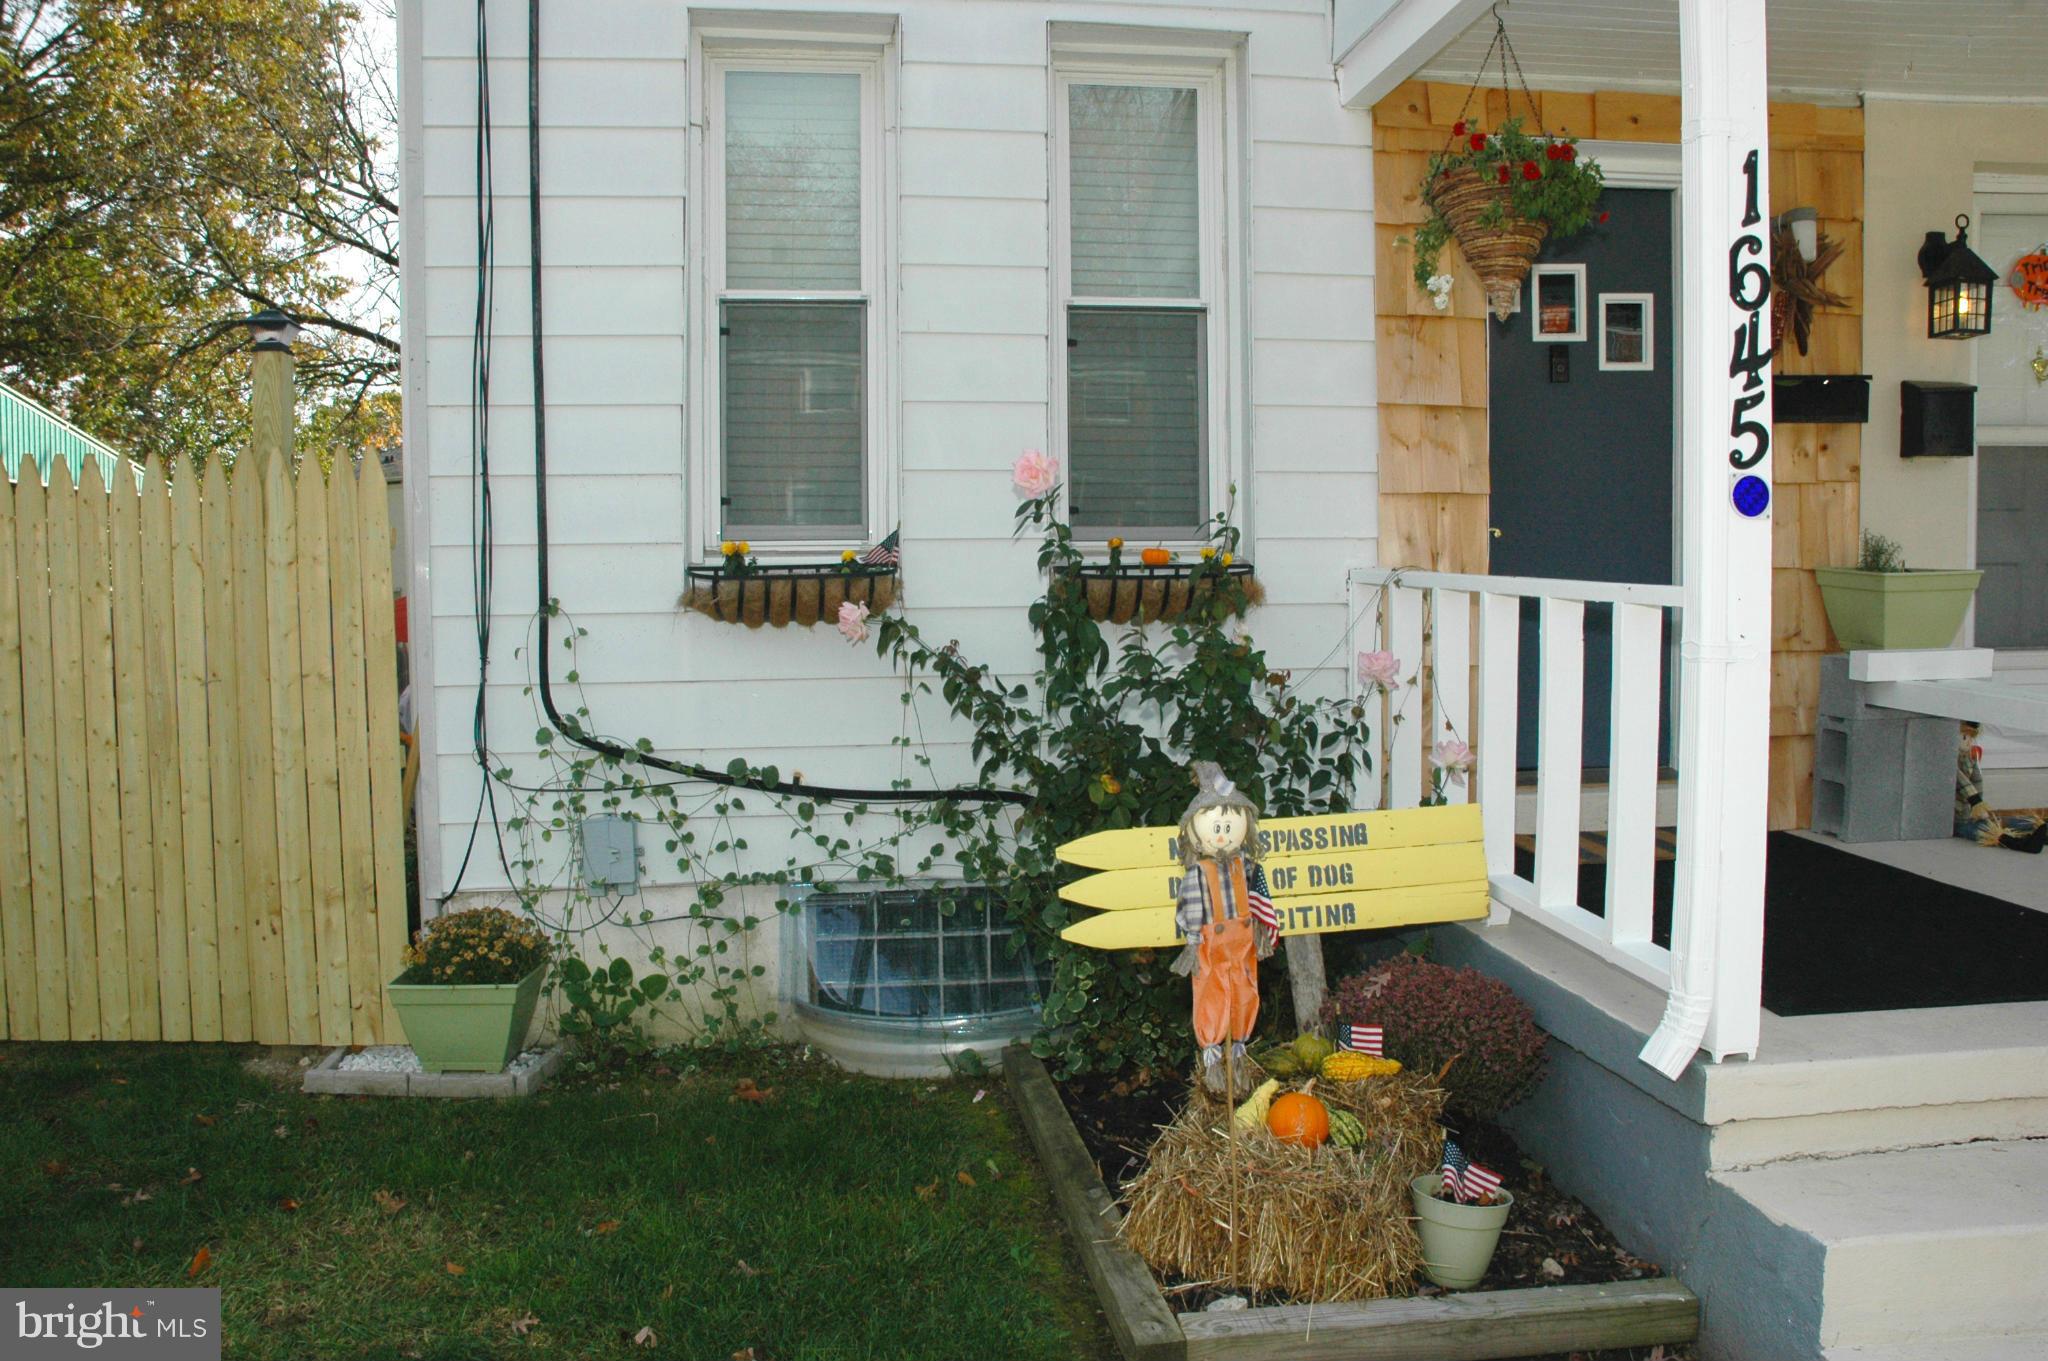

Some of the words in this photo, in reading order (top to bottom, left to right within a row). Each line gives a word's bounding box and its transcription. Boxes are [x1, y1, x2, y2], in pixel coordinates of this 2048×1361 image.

[1729, 149, 1772, 470] 1645
[1258, 822, 1368, 853] SPASSING
[1272, 866, 1297, 890] OF
[1307, 862, 1354, 888] DOG
[1274, 902, 1356, 931] CITING
